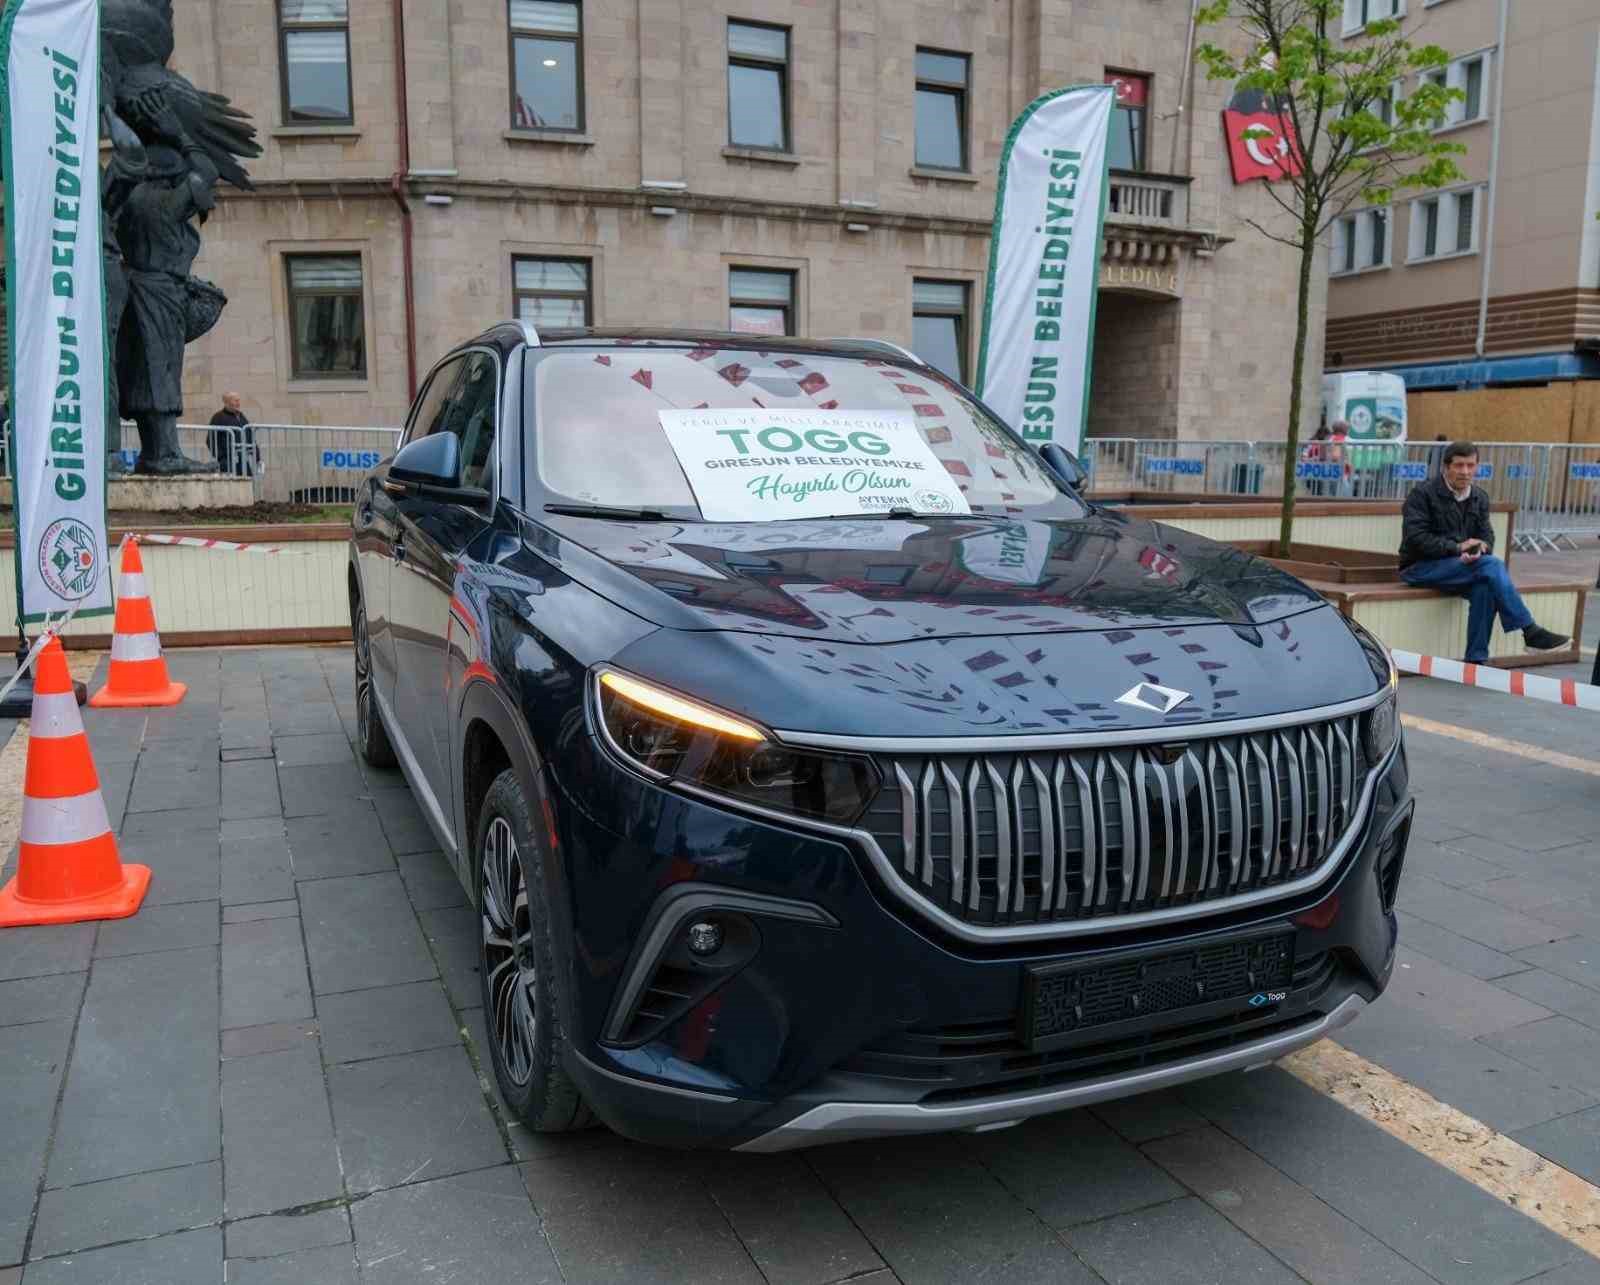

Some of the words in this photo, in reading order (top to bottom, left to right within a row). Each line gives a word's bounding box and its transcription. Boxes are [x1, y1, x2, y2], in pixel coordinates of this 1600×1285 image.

[1034, 148, 1082, 342] BELEDİYESİ
[44, 316, 87, 501] GİRESUN
[716, 426, 892, 456] TOGG
[1022, 356, 1059, 441] ESUN
[842, 469, 911, 493] Olsun
